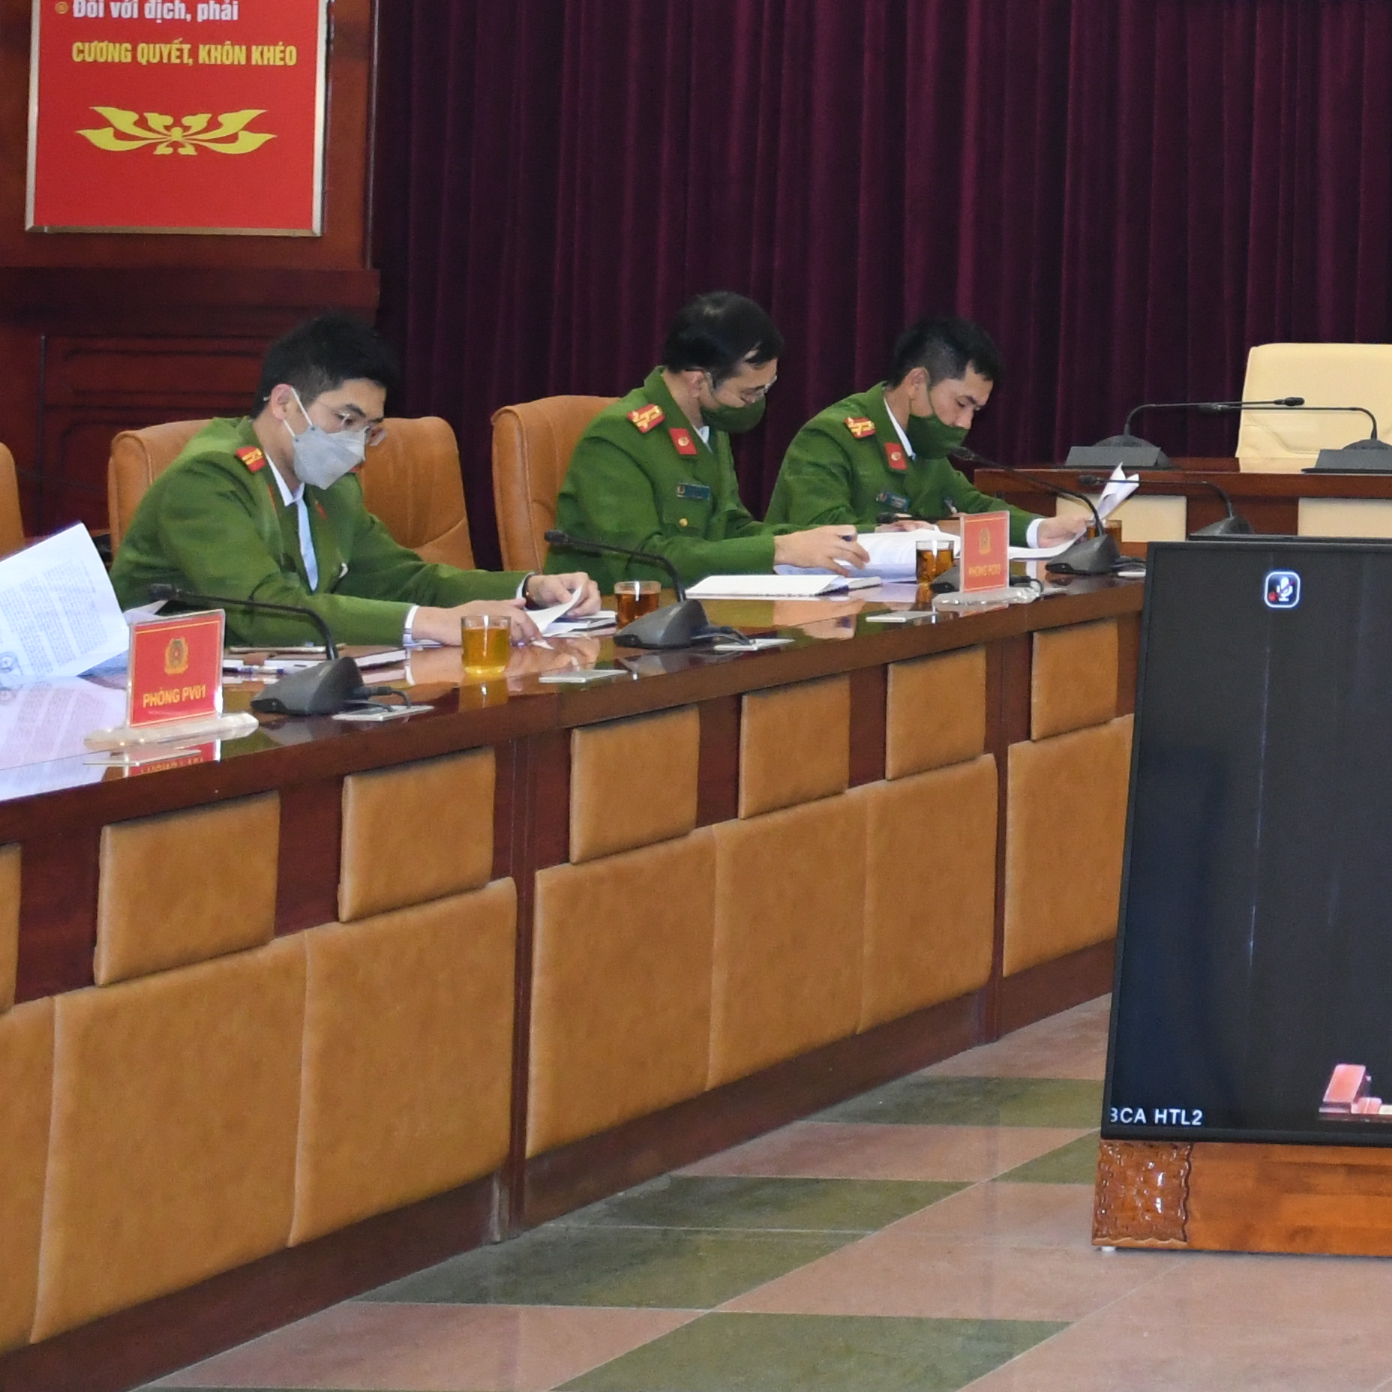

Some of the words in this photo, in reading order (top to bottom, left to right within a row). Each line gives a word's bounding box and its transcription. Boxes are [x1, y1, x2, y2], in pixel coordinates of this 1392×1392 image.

[144, 0, 191, 23] địch,
[72, 41, 132, 62] CƯƠNG
[137, 38, 193, 65] QUYẾT,
[199, 41, 246, 64] KHÔN
[252, 42, 296, 65] KHÉO
[143, 687, 180, 708] PHÒNG
[182, 685, 206, 700] PV01
[1155, 1109, 1202, 1125] HTL2
